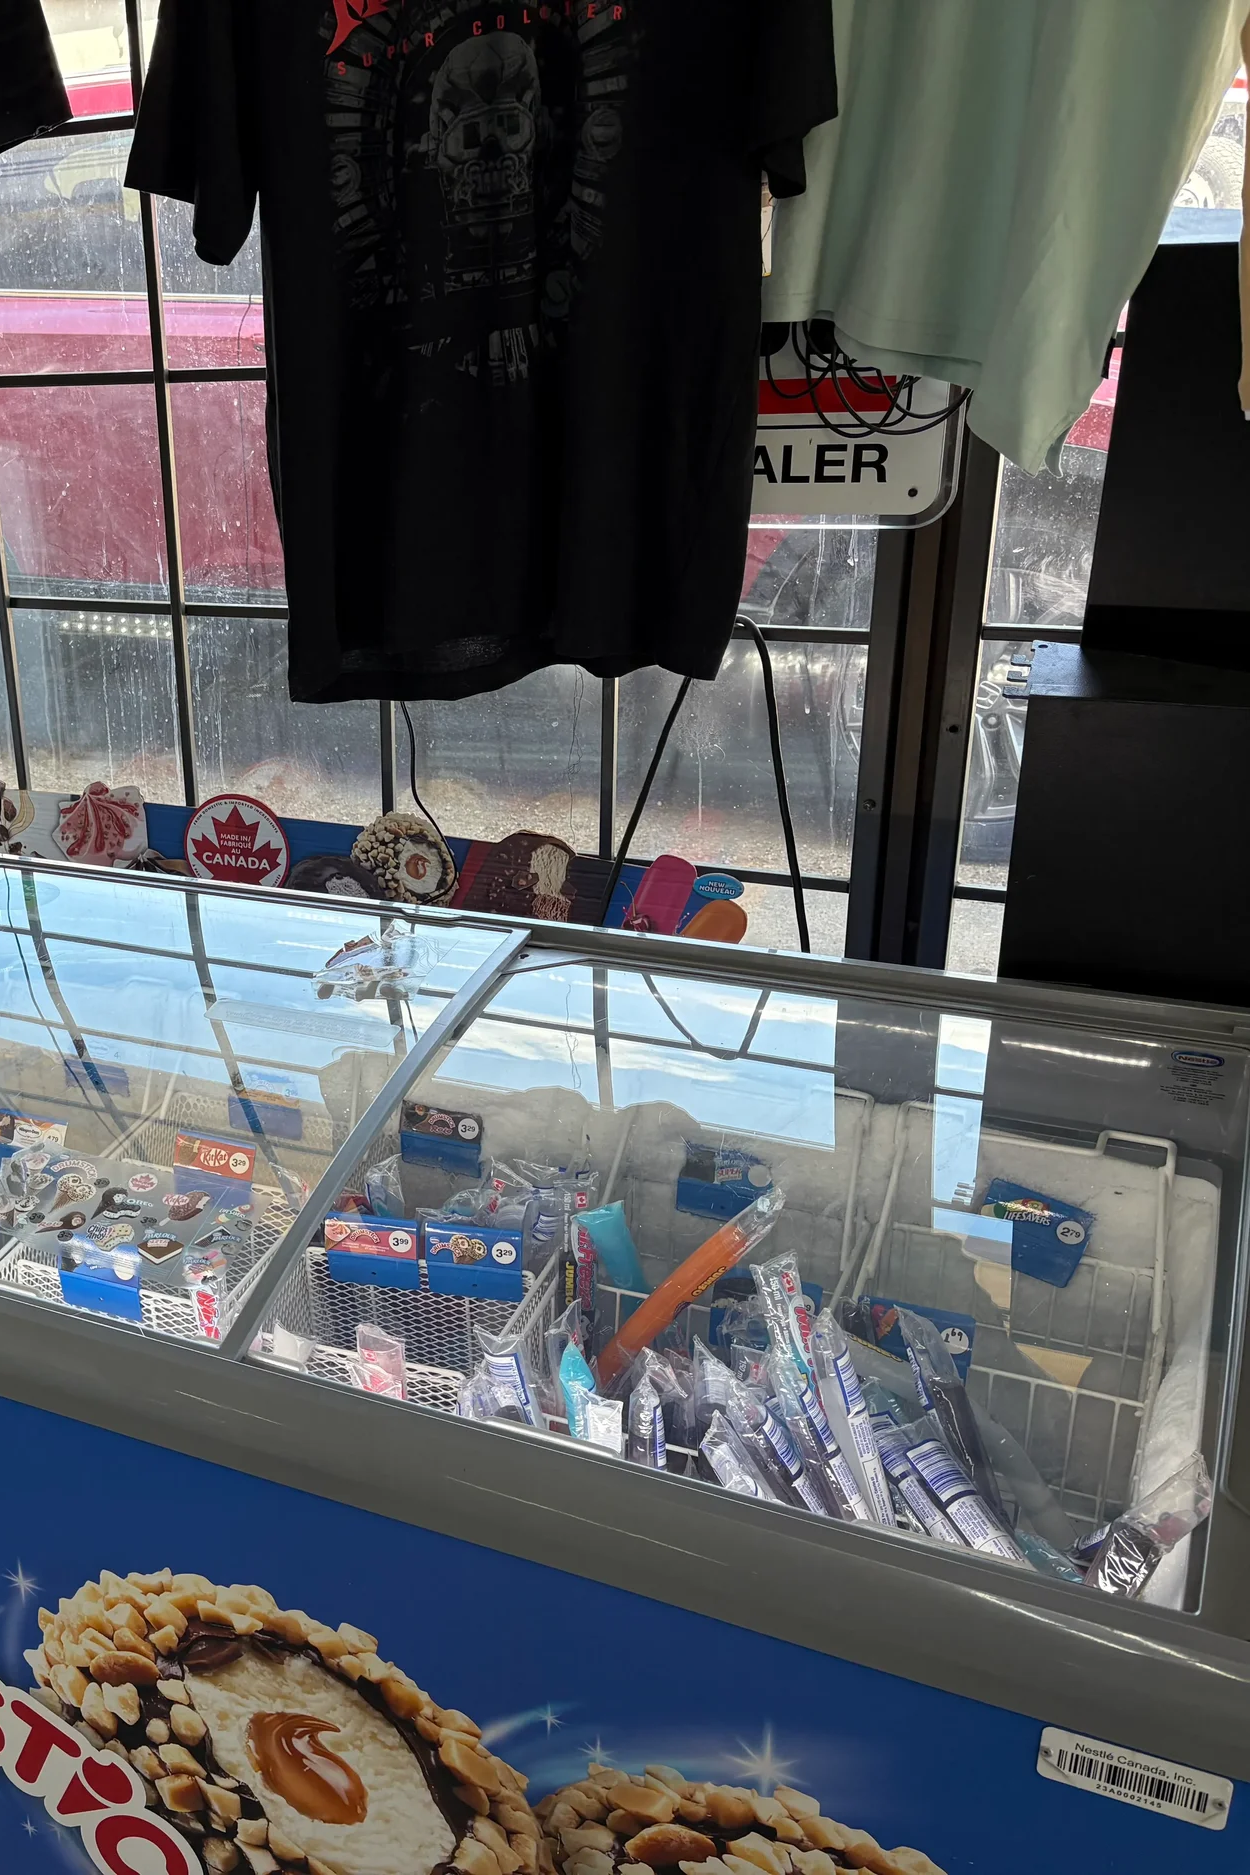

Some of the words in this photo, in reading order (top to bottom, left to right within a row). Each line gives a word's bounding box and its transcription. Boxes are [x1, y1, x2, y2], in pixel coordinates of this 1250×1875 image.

[220, 833, 239, 841] MADE
[220, 840, 252, 849] FABRIQUÉ
[202, 852, 271, 871] CANADA
[699, 885, 736, 896] NOUVEAU
[460, 1125, 476, 1133] 329
[202, 1148, 228, 1166] KitKat
[231, 1158, 247, 1168] 329
[50, 1159, 98, 1179] DRUMSTICK
[1003, 1210, 1051, 1226] LIFESAVERS
[1060, 1226, 1081, 1239] 279
[350, 1229, 380, 1244] DRUMSTICK
[392, 1237, 409, 1246] 399
[429, 1242, 463, 1258] DRUMSTICK
[495, 1249, 513, 1258] 329
[1074, 1742, 1114, 1762] Nestlé
[1173, 1771, 1197, 1787] Inc.
